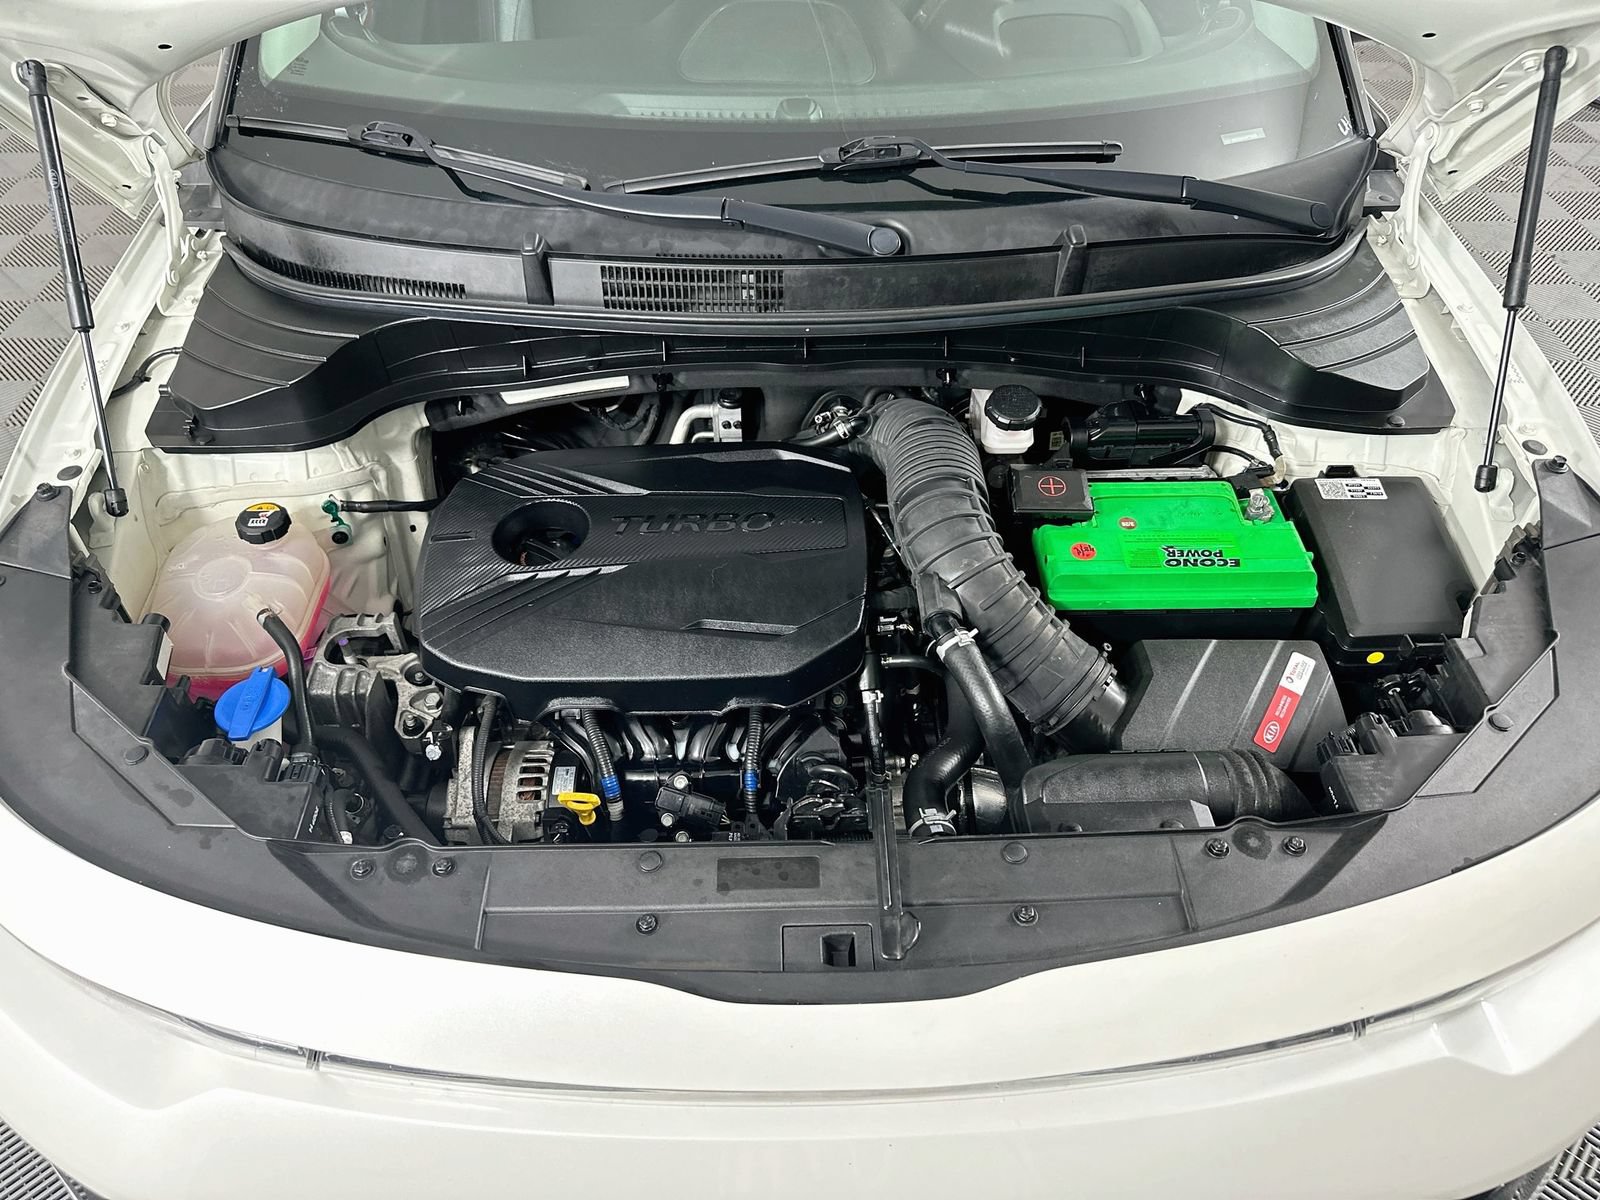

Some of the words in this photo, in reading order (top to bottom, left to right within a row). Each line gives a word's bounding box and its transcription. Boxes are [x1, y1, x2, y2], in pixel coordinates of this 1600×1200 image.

[611, 511, 776, 536] TURBO
[1165, 548, 1224, 558] POWER
[1163, 558, 1241, 568] ECONO
[1265, 724, 1279, 740] KIA
